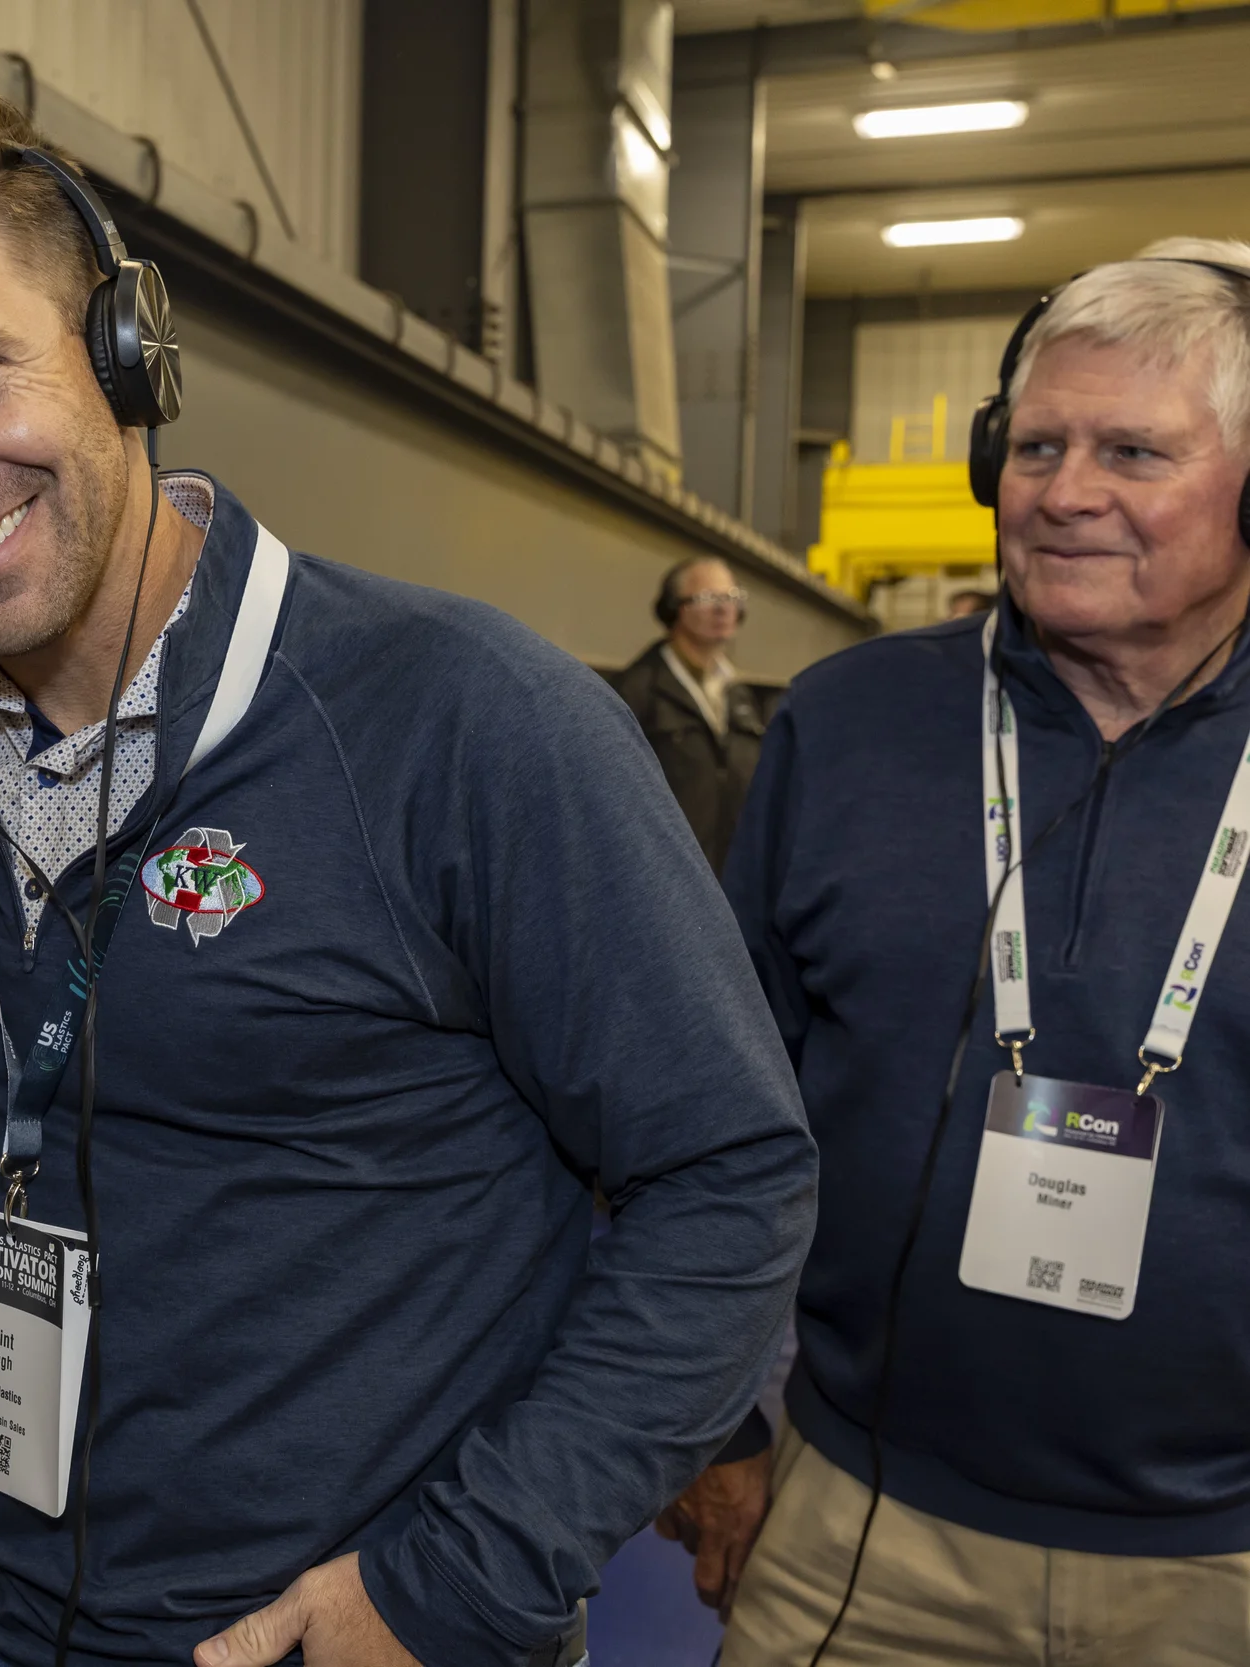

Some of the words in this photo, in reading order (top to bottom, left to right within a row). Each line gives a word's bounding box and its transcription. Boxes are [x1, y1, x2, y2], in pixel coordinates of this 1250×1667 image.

[52, 1010, 72, 1051] PLASTICS
[60, 1031, 74, 1054] PACT
[1065, 1111, 1120, 1136] RCon
[1028, 1172, 1087, 1197] Douglas
[1036, 1192, 1073, 1211] Miner
[12, 1241, 41, 1257] LASTICS
[44, 1250, 58, 1265] PACT
[1, 1280, 15, 1292] 11-12
[17, 1272, 57, 1299] SUMMIT
[9, 1420, 26, 1436] Sales
